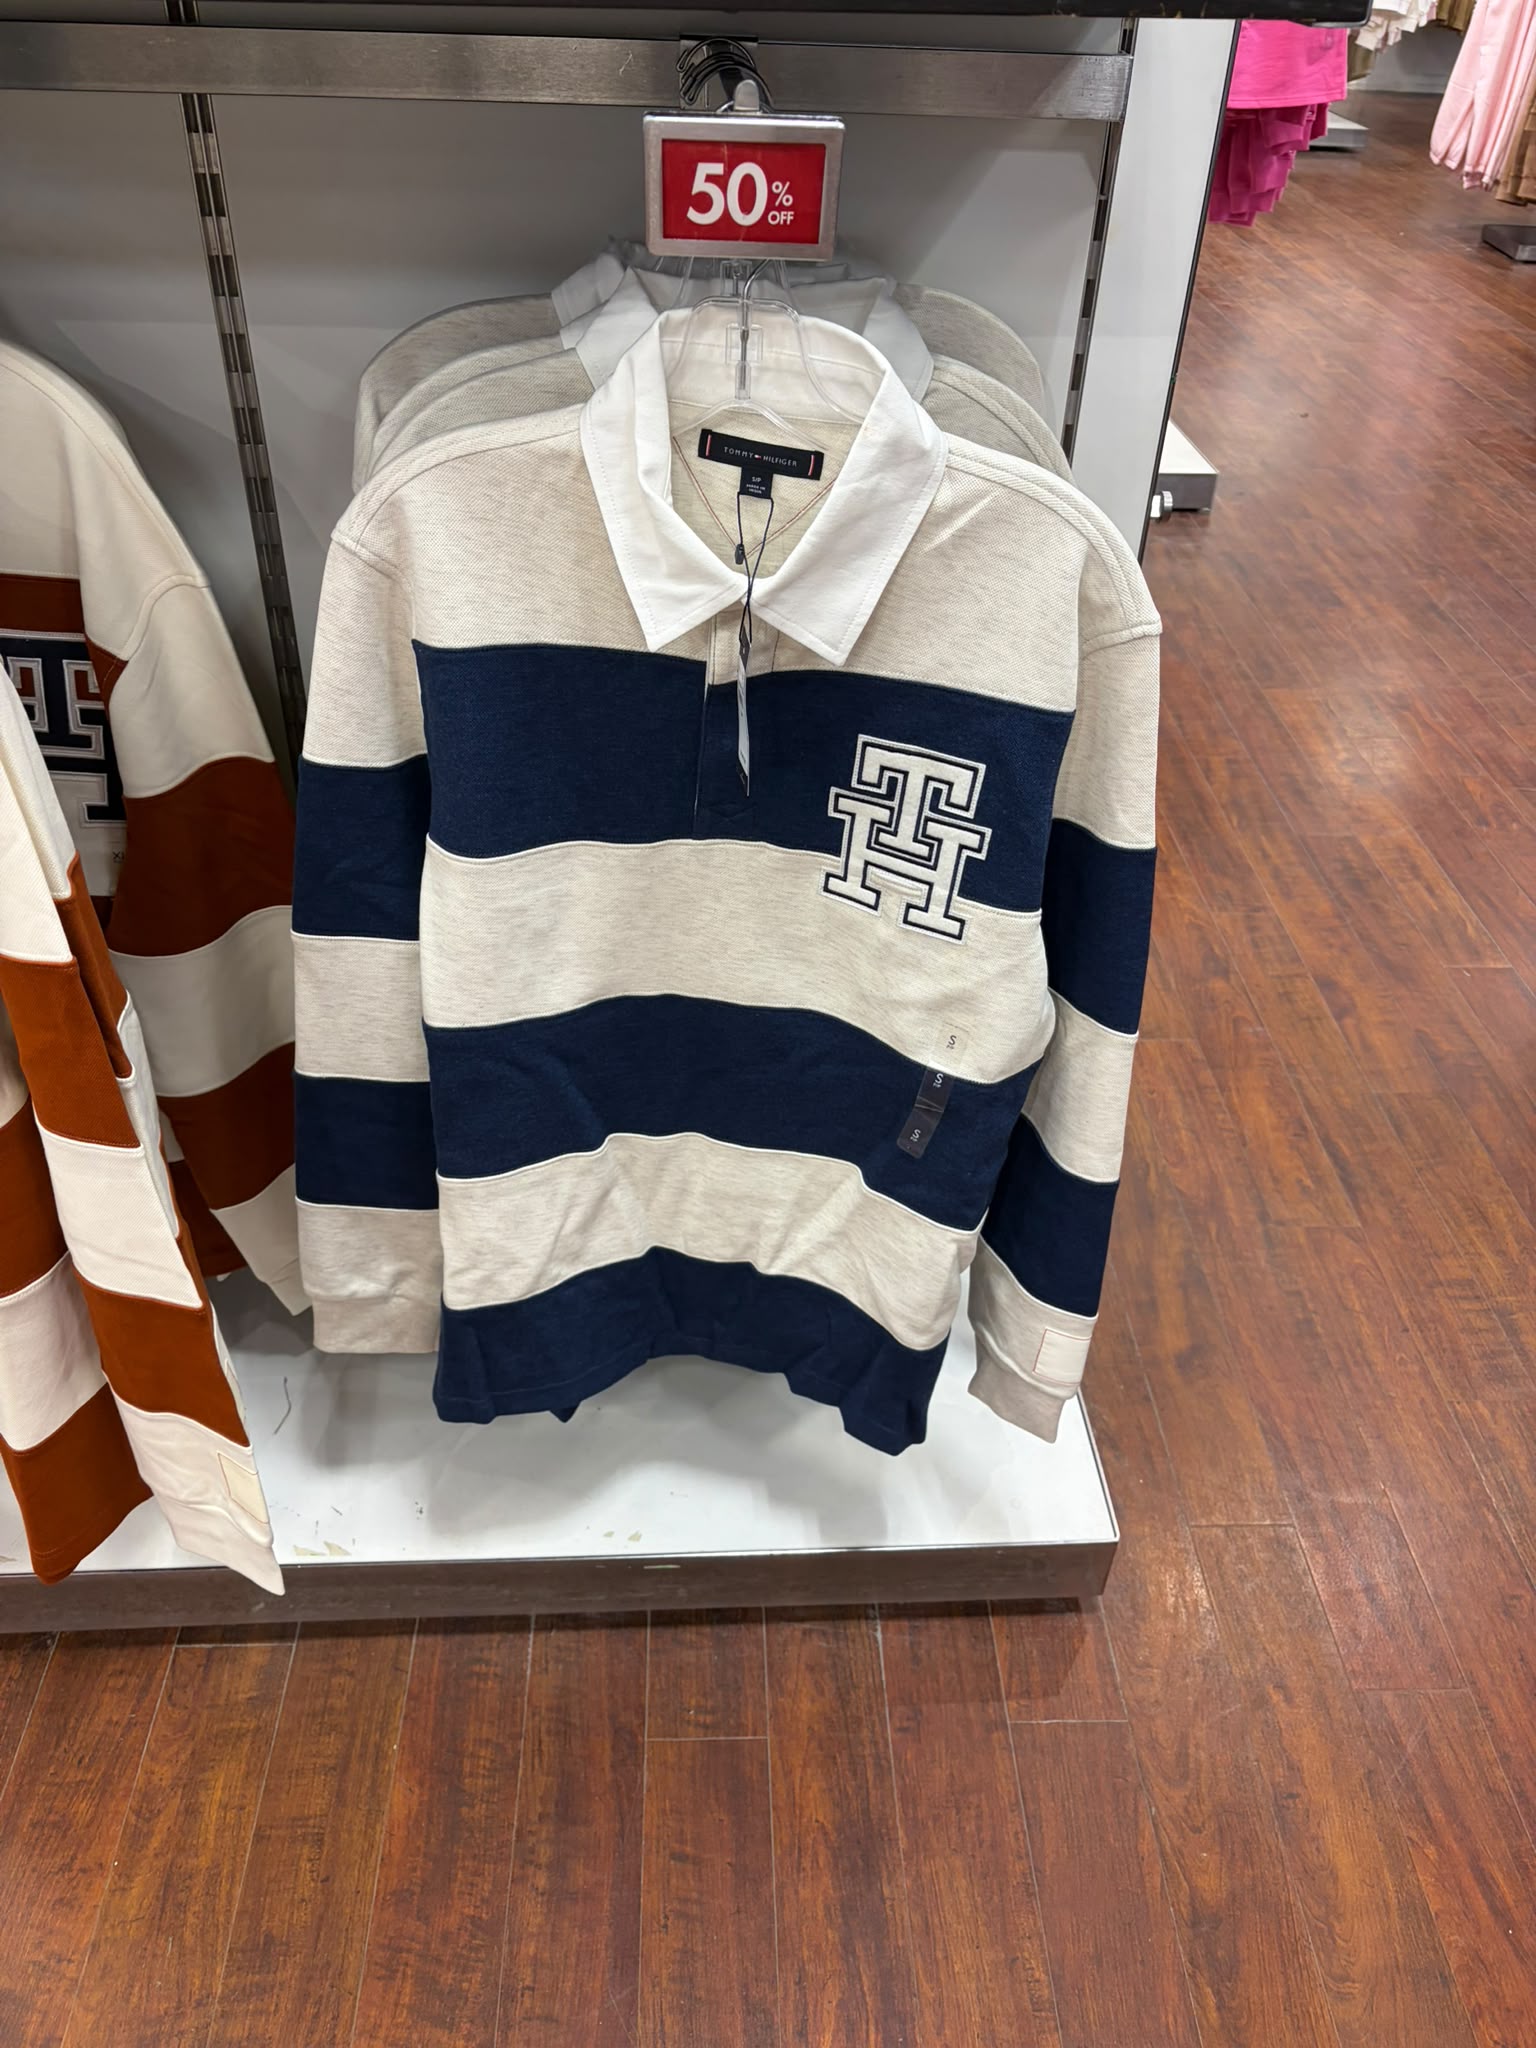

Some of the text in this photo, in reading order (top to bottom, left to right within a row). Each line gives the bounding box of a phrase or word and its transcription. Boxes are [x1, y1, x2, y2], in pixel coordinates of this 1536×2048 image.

[767, 211, 794, 225] OFF
[724, 446, 797, 467] TOMMY HILFIGER
[948, 1035, 957, 1045] S
[935, 1073, 944, 1083] S
[912, 1129, 921, 1138] S
